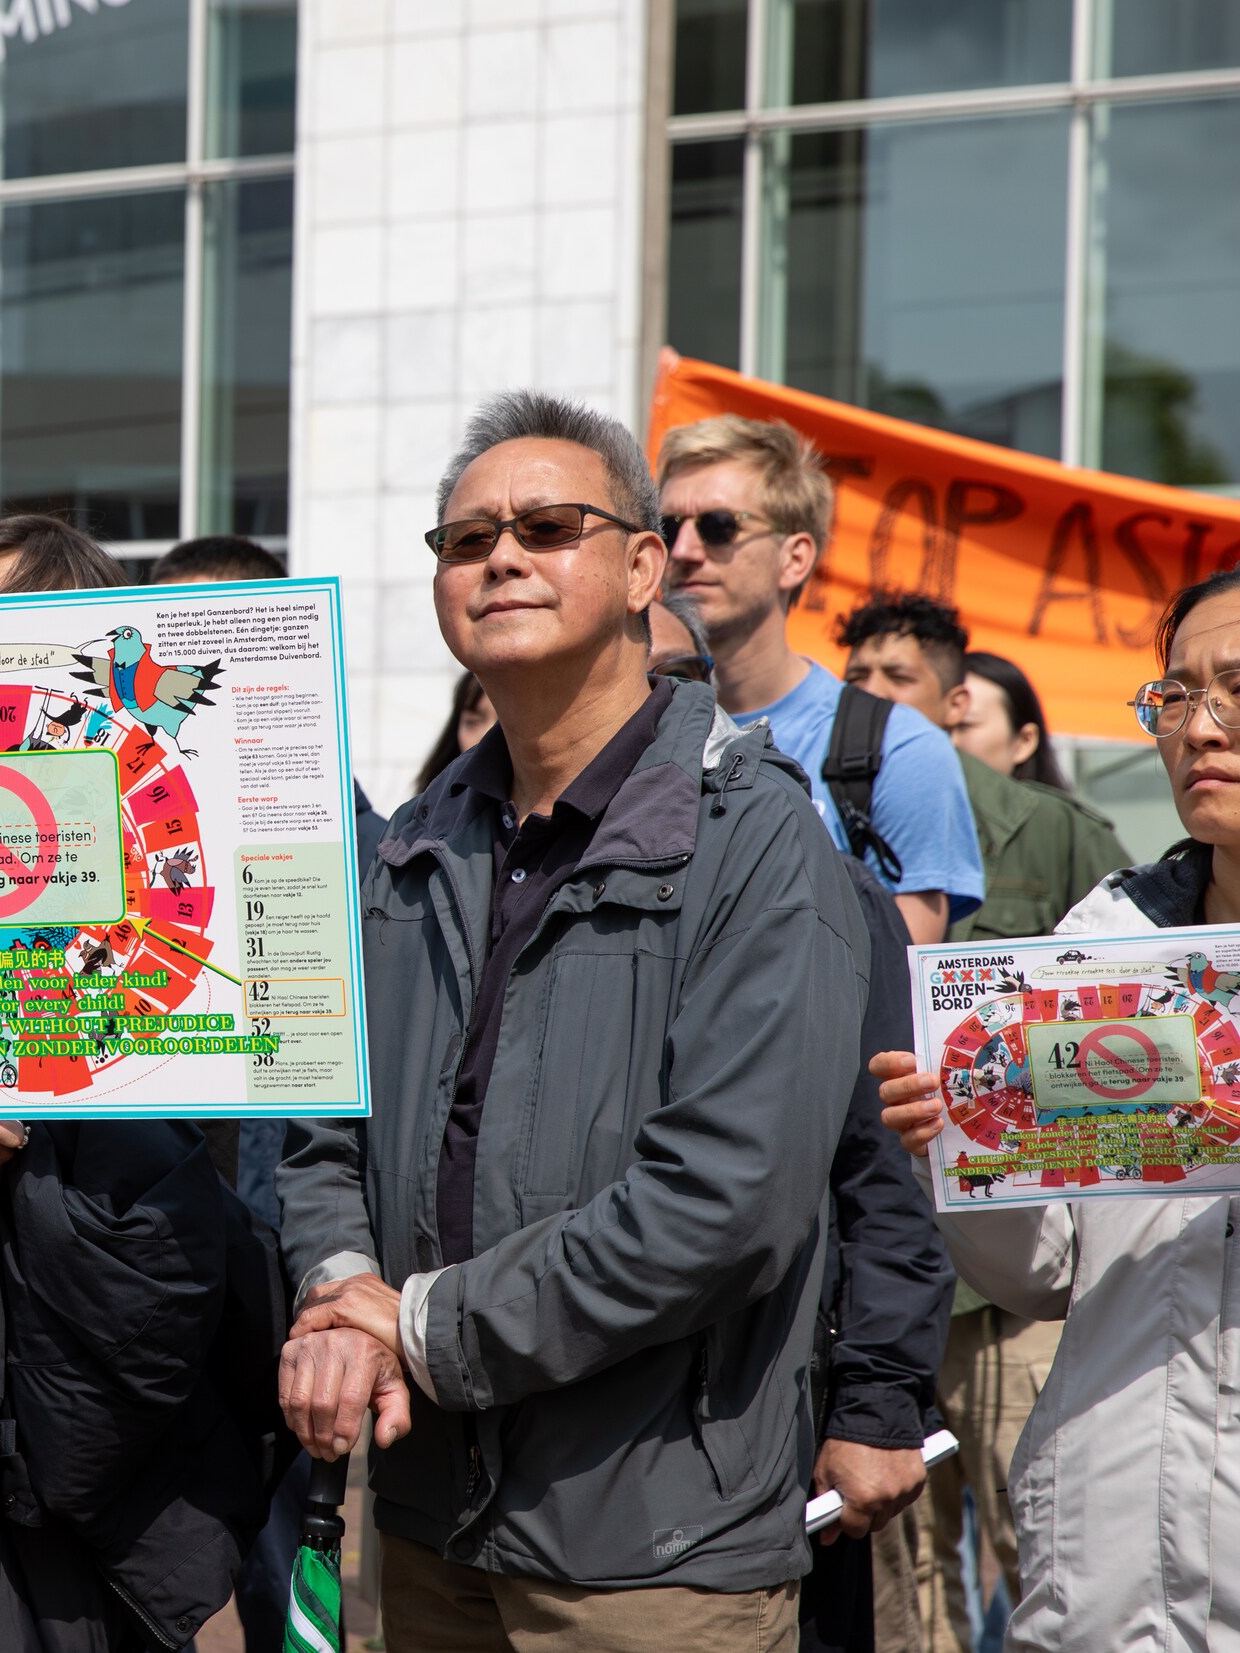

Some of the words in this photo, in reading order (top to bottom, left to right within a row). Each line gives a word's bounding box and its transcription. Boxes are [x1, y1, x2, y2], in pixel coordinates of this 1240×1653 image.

[1028, 500, 1240, 648] ASI
[170, 612, 177, 620] je
[191, 610, 205, 618] spel
[207, 607, 253, 616] Ganzenbord?
[293, 604, 316, 612] simpel
[167, 620, 202, 629] superleuk.
[203, 620, 211, 628] Je
[250, 626, 281, 634] dingetje:
[283, 625, 309, 633] ganzen
[233, 635, 275, 643] Amsterdam,
[297, 643, 306, 651] bij
[18, 653, 27, 665] de
[230, 655, 277, 663] Amsterdamse
[279, 652, 321, 660] Duivenbord.
[266, 684, 289, 693] regels:
[0, 705, 16, 723] 20
[35, 830, 91, 843] toeristen
[20, 852, 43, 864] Om
[48, 854, 62, 863] ze
[65, 851, 78, 862] te
[241, 854, 270, 863] Speciale
[271, 853, 293, 862] vakjes
[9, 876, 39, 885] naar
[43, 871, 77, 887] vakje
[81, 871, 100, 883] 39.
[242, 864, 253, 884] 6
[246, 901, 264, 921] 19
[246, 937, 265, 957] 31
[937, 955, 1014, 970] AMSTERDAMS
[30, 978, 67, 989] voor
[74, 974, 116, 988] ieder
[123, 973, 168, 987] kind!
[249, 981, 269, 1001] 42
[931, 983, 995, 998] DUIVEN-
[25, 1000, 70, 1015] every
[77, 996, 125, 1010] child!
[933, 997, 973, 1012] BORD
[9, 1018, 108, 1034] WITHOUT
[115, 1015, 234, 1032] PREJUDICE
[251, 1018, 271, 1037] 52
[14, 1040, 98, 1055] ZONDER
[106, 1037, 279, 1054] VOOROORDELEN
[1048, 1042, 1080, 1070] 42
[1115, 1057, 1145, 1065] Chinese
[656, 1540, 698, 1556] nom
